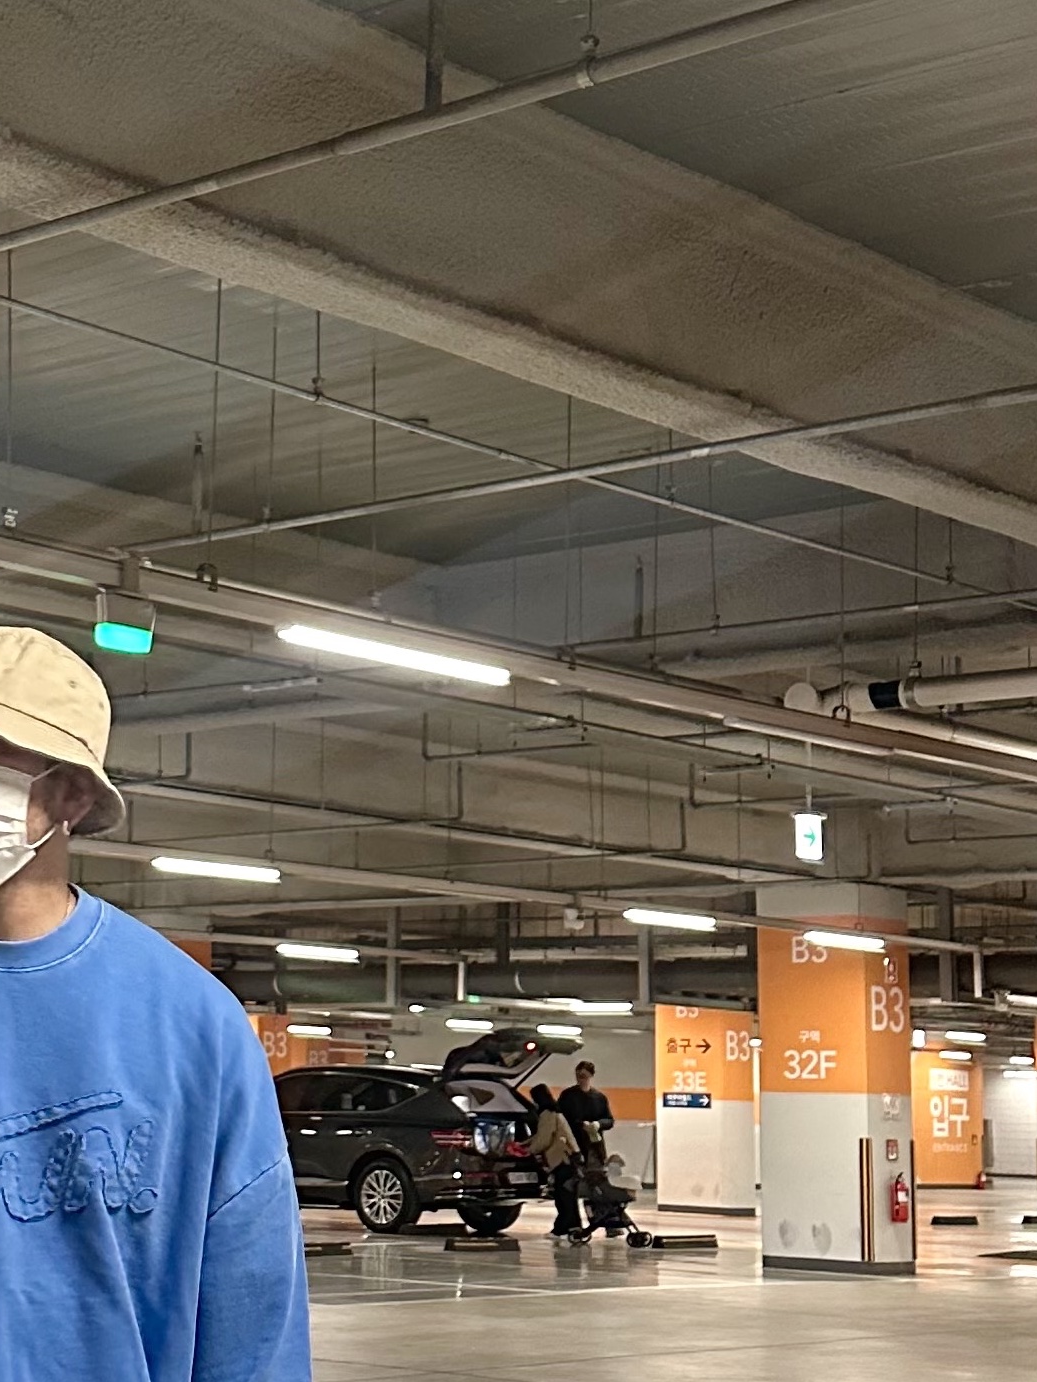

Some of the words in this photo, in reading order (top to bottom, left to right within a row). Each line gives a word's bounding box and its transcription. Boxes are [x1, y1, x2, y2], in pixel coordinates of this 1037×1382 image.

[791, 936, 828, 963] B3
[870, 985, 905, 1034] B3
[264, 1031, 288, 1058] B3
[666, 1038, 692, 1054] 출구
[726, 1030, 751, 1062] B3
[783, 1050, 838, 1080] 32F
[672, 1070, 708, 1093] 33E
[930, 1095, 970, 1138] 입구
